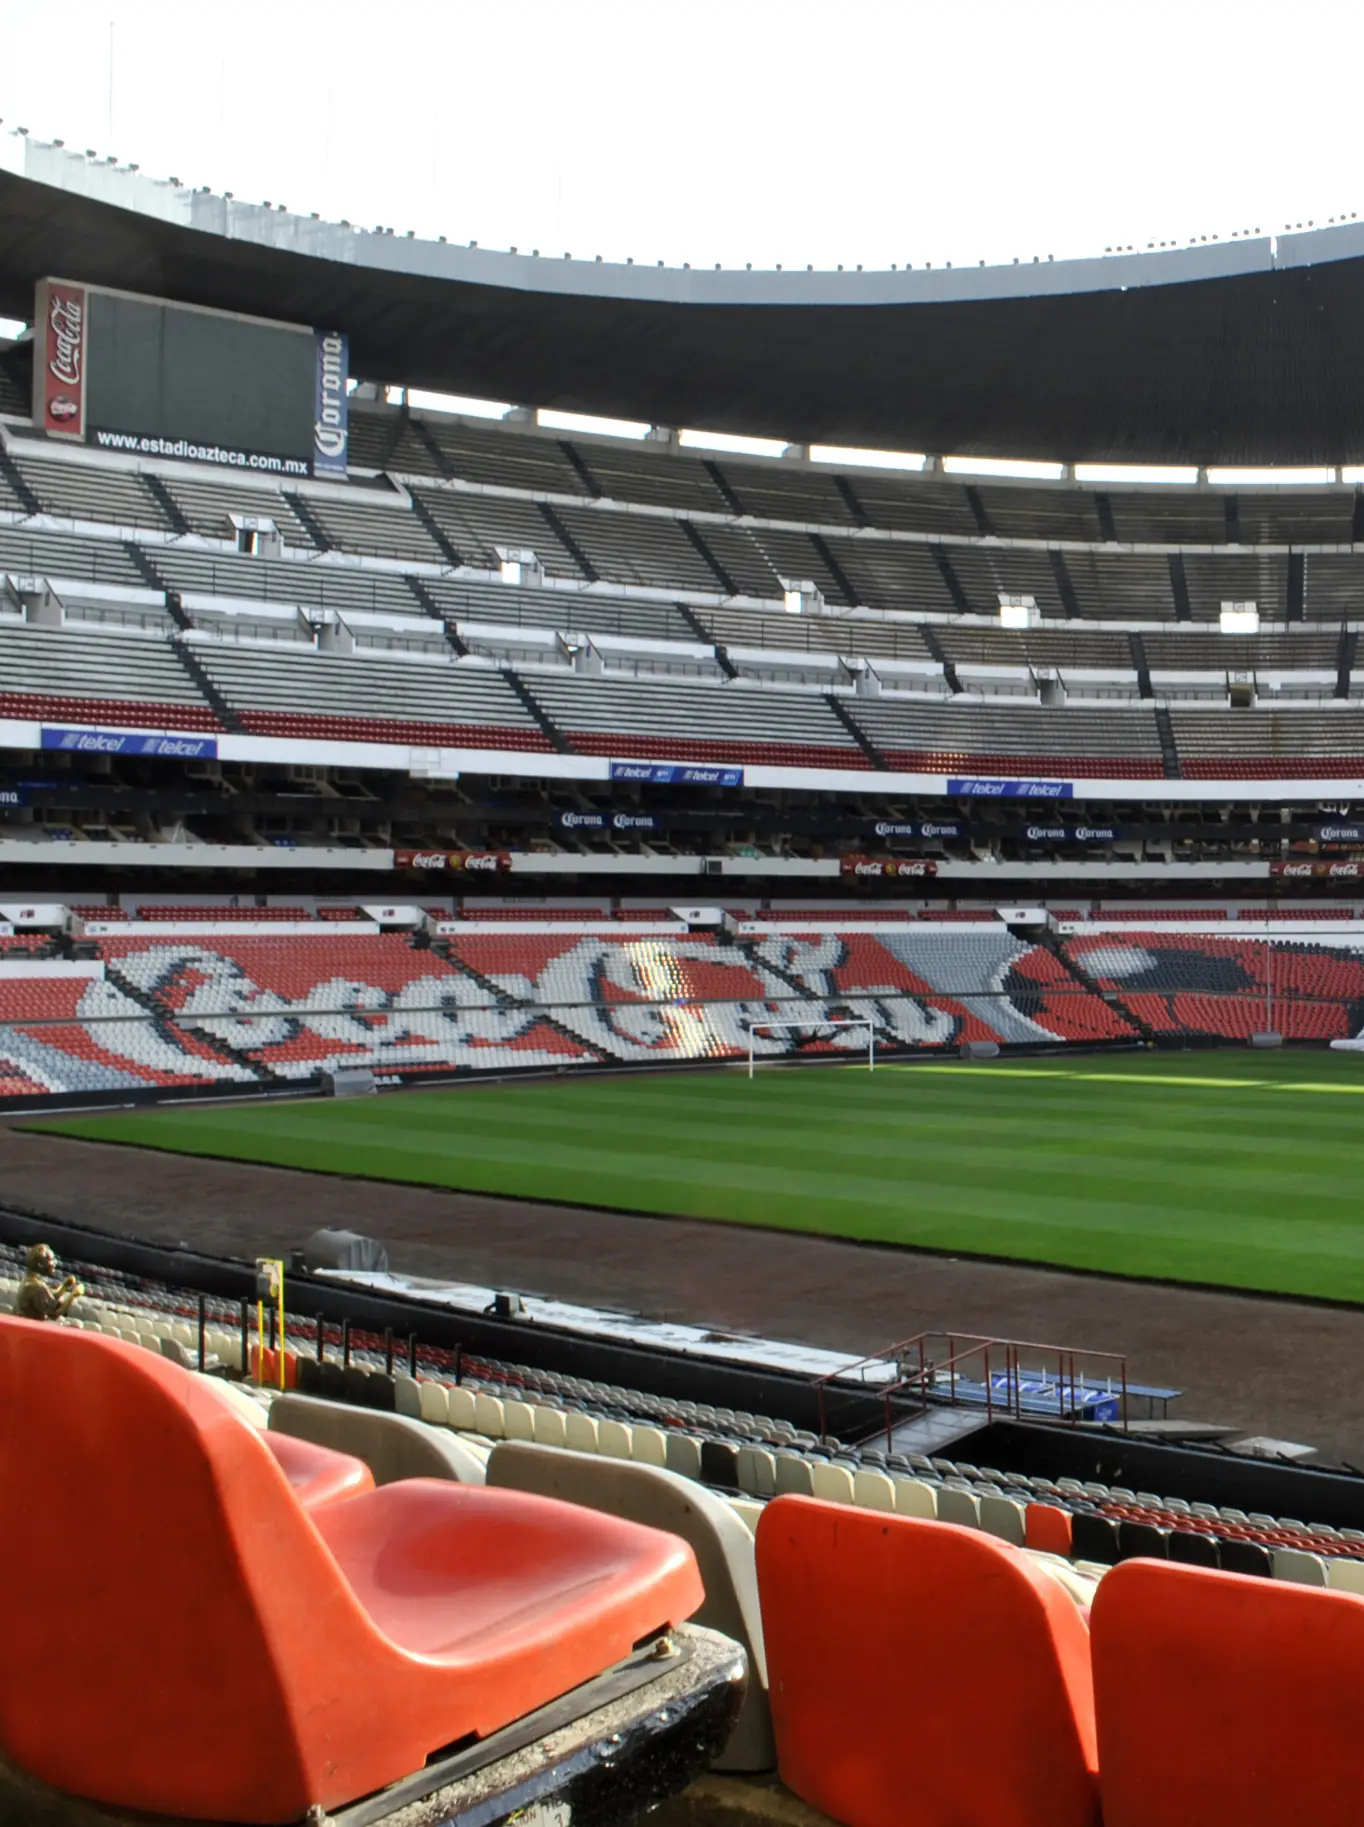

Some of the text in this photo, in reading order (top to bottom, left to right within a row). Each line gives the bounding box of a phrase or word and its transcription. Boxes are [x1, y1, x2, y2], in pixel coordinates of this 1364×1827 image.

[315, 332, 348, 457] Corona
[97, 431, 308, 475] www.estadioazteca.com.mx
[78, 735, 204, 756] telcel telcel
[972, 783, 1062, 796] telcel telcel
[562, 812, 653, 830] Corona Corona
[875, 822, 958, 838] Corona Corona
[1027, 826, 1114, 841] Corona Corona
[1320, 826, 1359, 841] Corona
